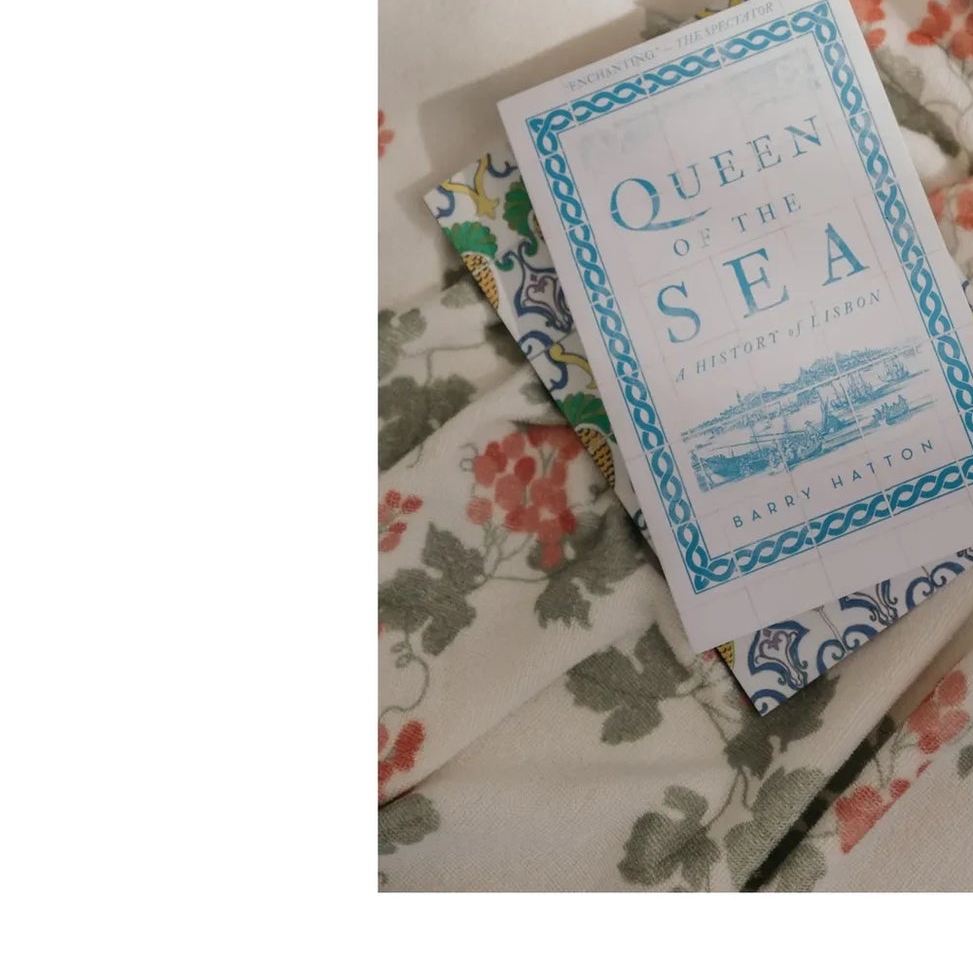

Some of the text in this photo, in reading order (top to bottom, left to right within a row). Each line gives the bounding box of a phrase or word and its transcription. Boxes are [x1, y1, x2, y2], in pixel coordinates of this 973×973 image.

[610, 116, 823, 231] QUEEN
[672, 193, 801, 257] OF THE
[656, 222, 871, 344] SEA
[675, 290, 882, 383] A HISTORY of LISBON
[732, 439, 935, 528] BARRY HATTON
